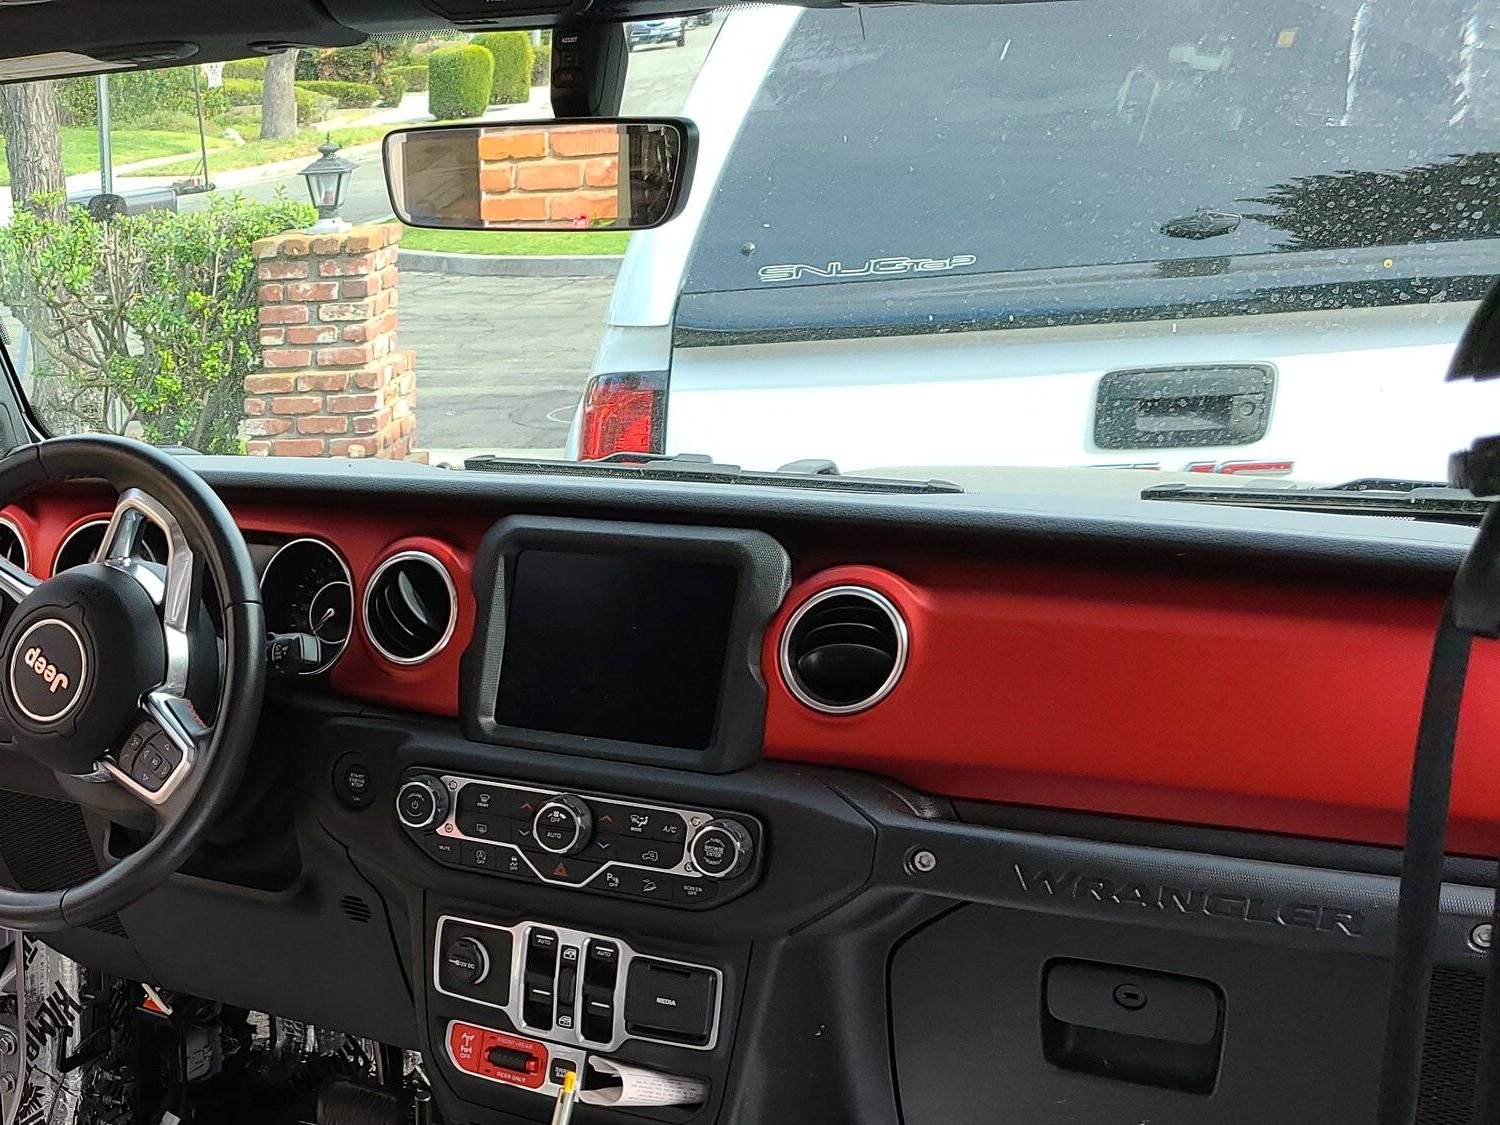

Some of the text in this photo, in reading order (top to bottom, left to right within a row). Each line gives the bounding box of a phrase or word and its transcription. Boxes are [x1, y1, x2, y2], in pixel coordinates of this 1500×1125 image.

[24, 646, 69, 693] Jeep
[662, 825, 677, 833] A/C
[546, 831, 562, 839] AUTO
[656, 997, 676, 1006] MEDIA
